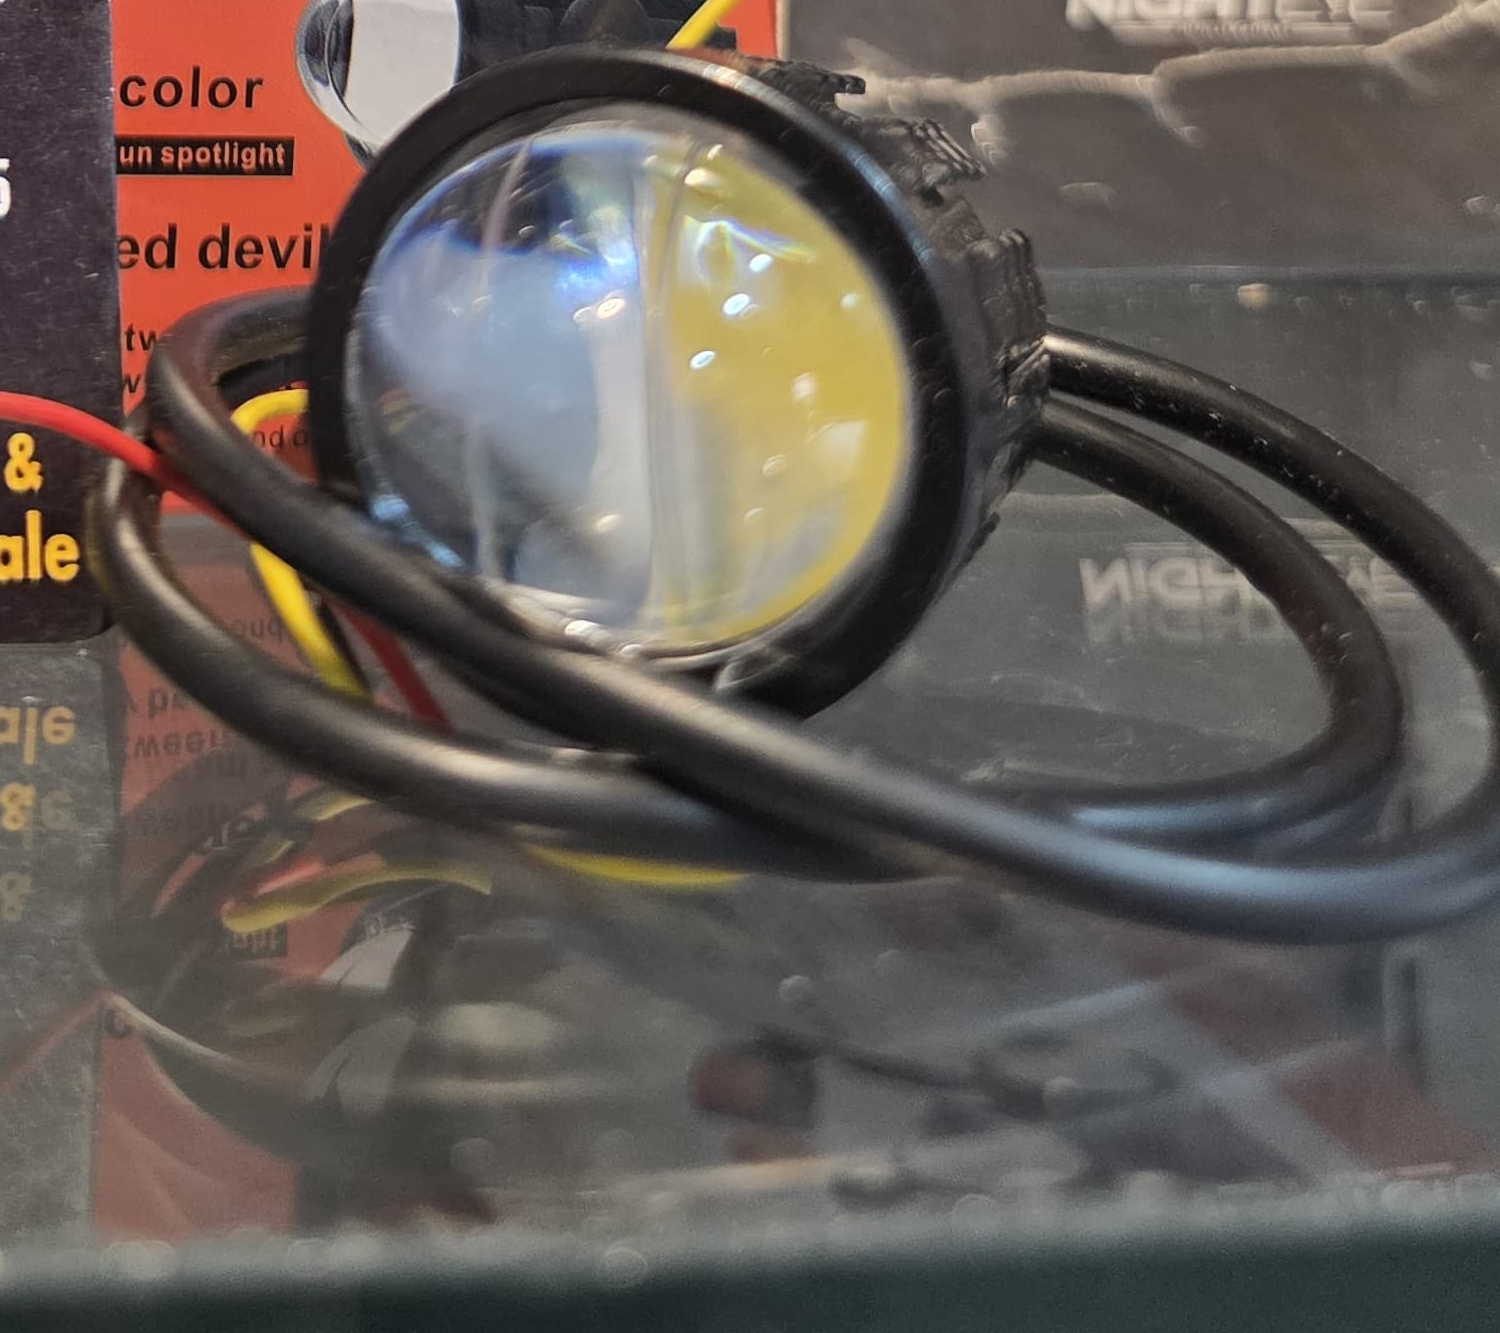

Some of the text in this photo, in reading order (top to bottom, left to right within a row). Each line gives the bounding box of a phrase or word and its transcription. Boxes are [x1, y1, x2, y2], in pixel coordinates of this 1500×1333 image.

[119, 65, 264, 109] color
[160, 141, 286, 172] spotlight
[117, 222, 178, 270] ed
[3, 432, 44, 494] &
